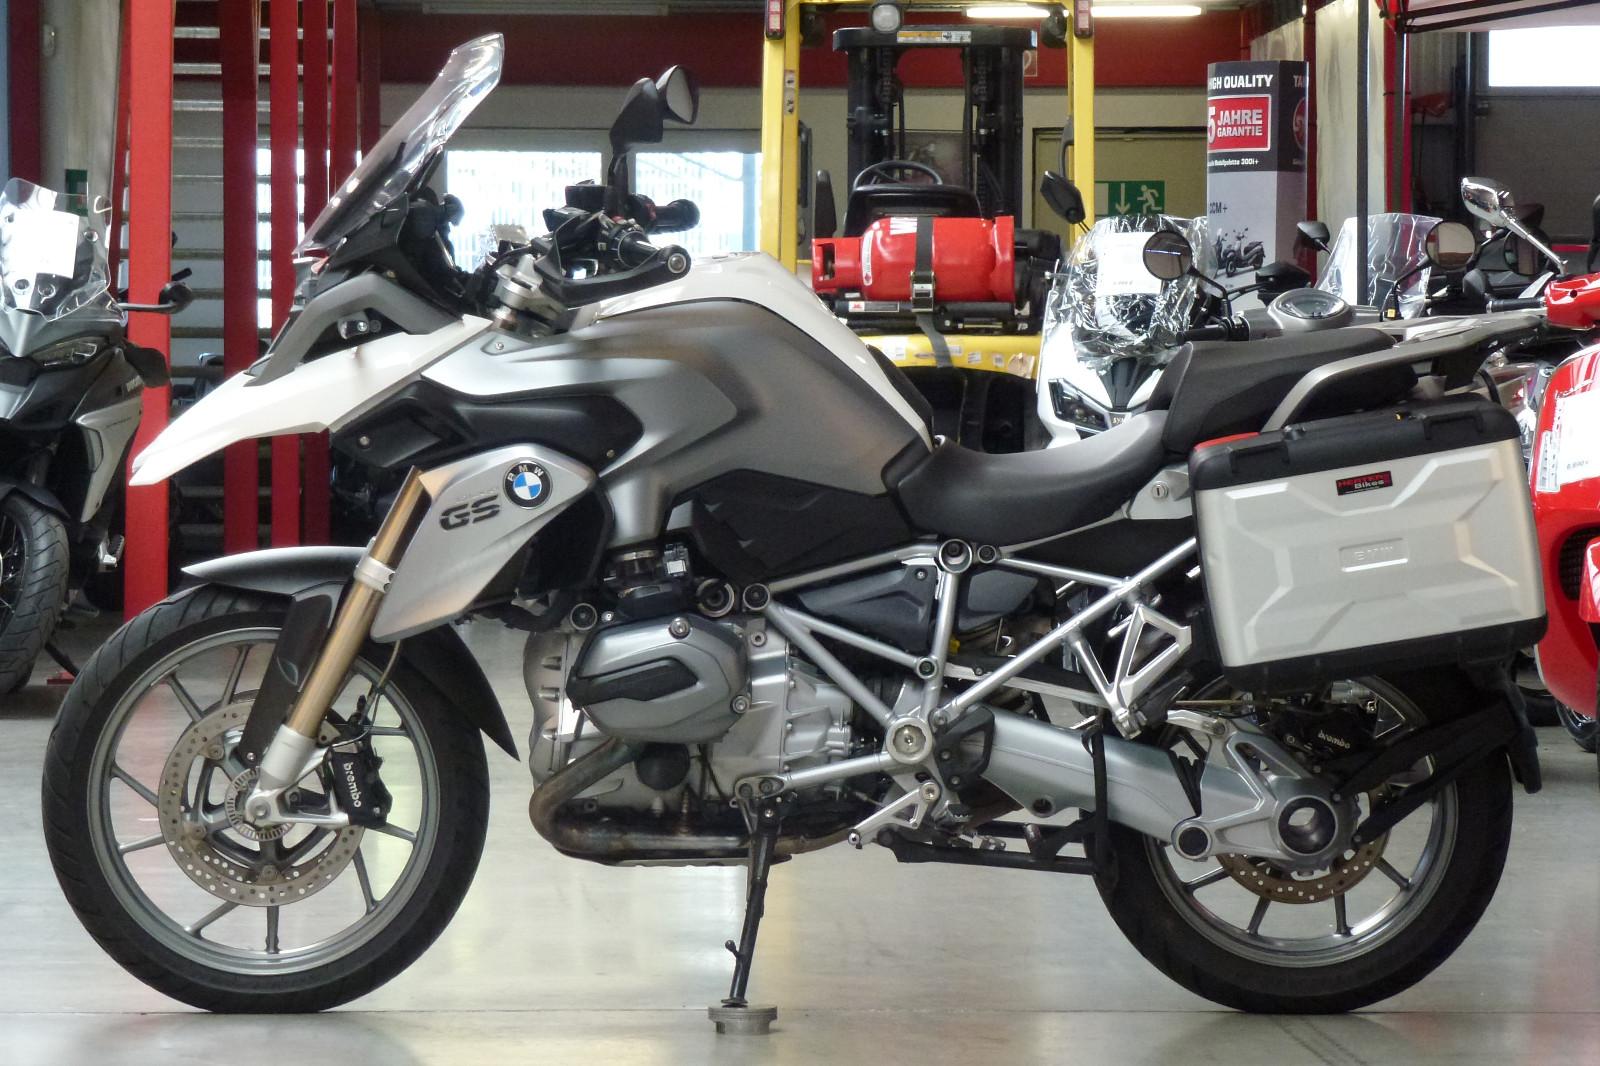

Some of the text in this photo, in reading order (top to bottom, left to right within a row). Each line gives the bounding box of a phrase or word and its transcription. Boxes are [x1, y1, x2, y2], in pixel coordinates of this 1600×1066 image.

[1223, 74, 1273, 89] QUALITY
[1208, 106, 1216, 144] 5
[1217, 109, 1263, 126] JAHRE
[1217, 126, 1263, 138] GARANTIE
[507, 464, 544, 482] BMW
[439, 494, 500, 531] GS
[343, 762, 362, 808] brembo
